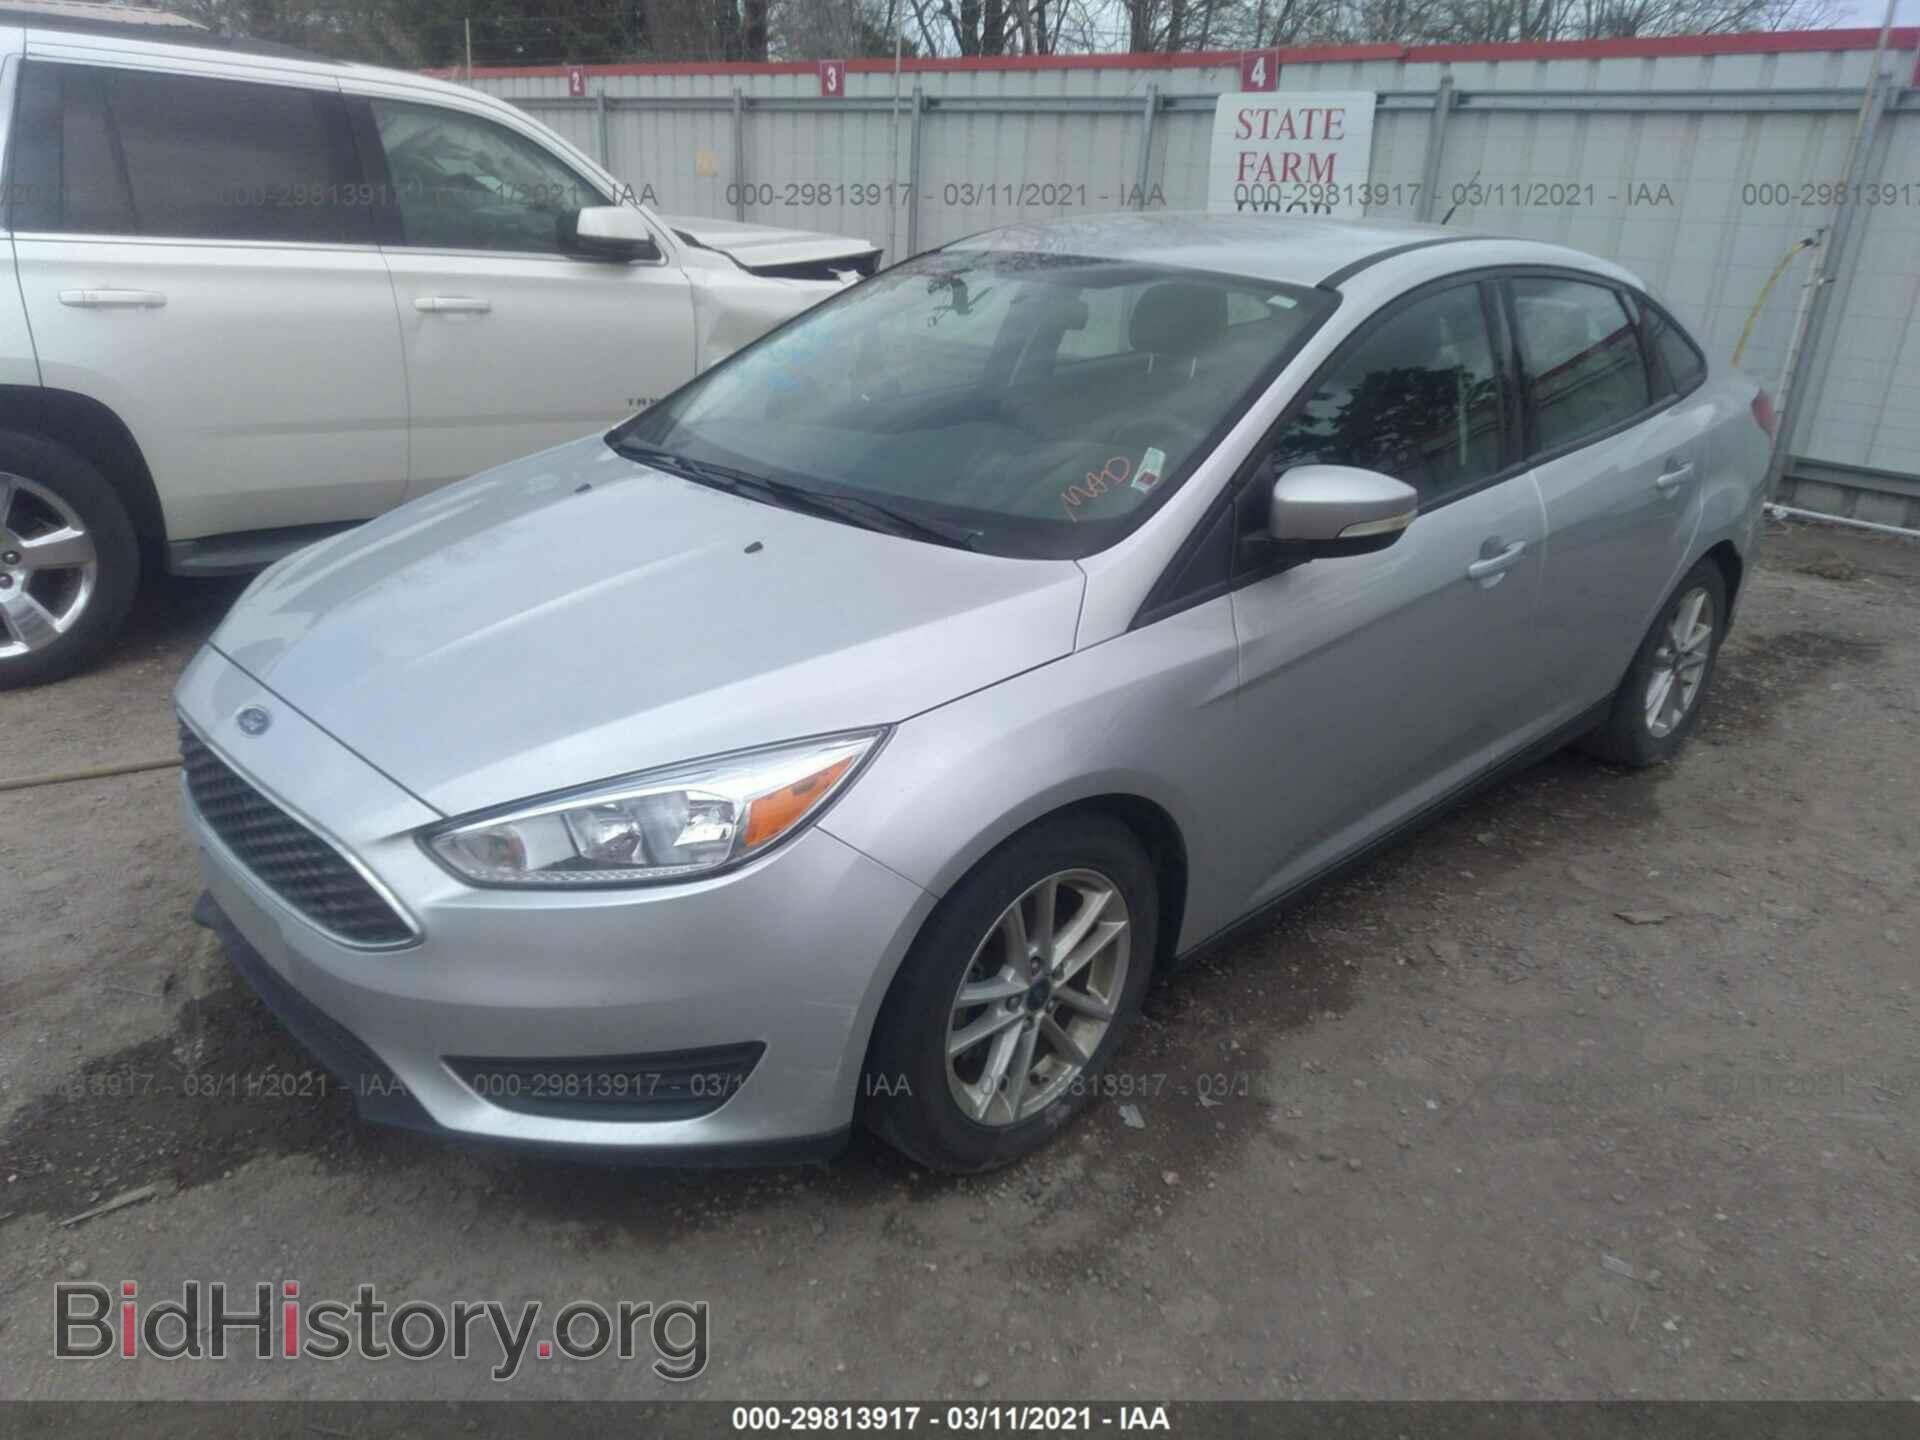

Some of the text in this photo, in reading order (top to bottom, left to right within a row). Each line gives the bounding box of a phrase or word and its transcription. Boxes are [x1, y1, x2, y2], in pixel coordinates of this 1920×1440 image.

[571, 71, 580, 92] 2
[827, 67, 837, 91] 3
[1250, 56, 1267, 88] 4
[1235, 107, 1346, 141] STATE
[1236, 151, 1338, 184] FARM
